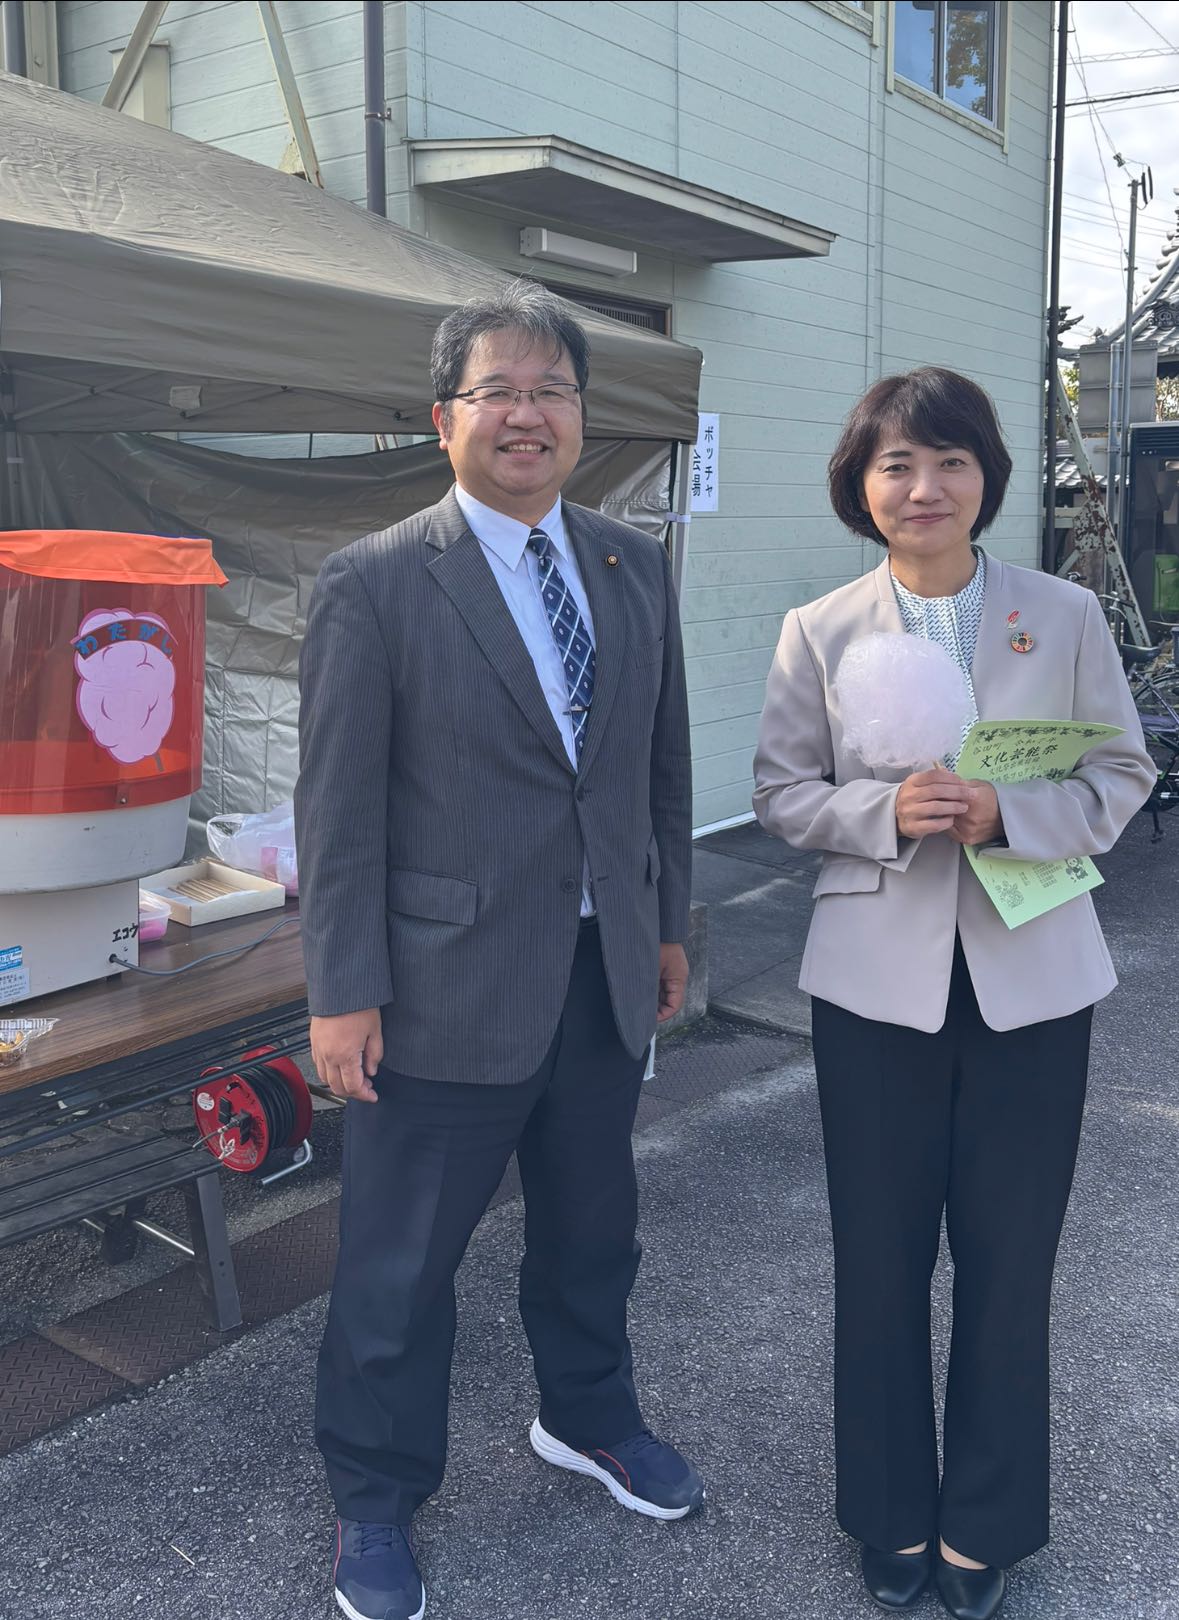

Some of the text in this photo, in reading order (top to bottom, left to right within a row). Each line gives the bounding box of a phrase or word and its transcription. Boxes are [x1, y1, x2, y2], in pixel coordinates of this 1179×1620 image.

[75, 623, 172, 655] わたがし
[979, 744, 1058, 770] 文化芸能祭
